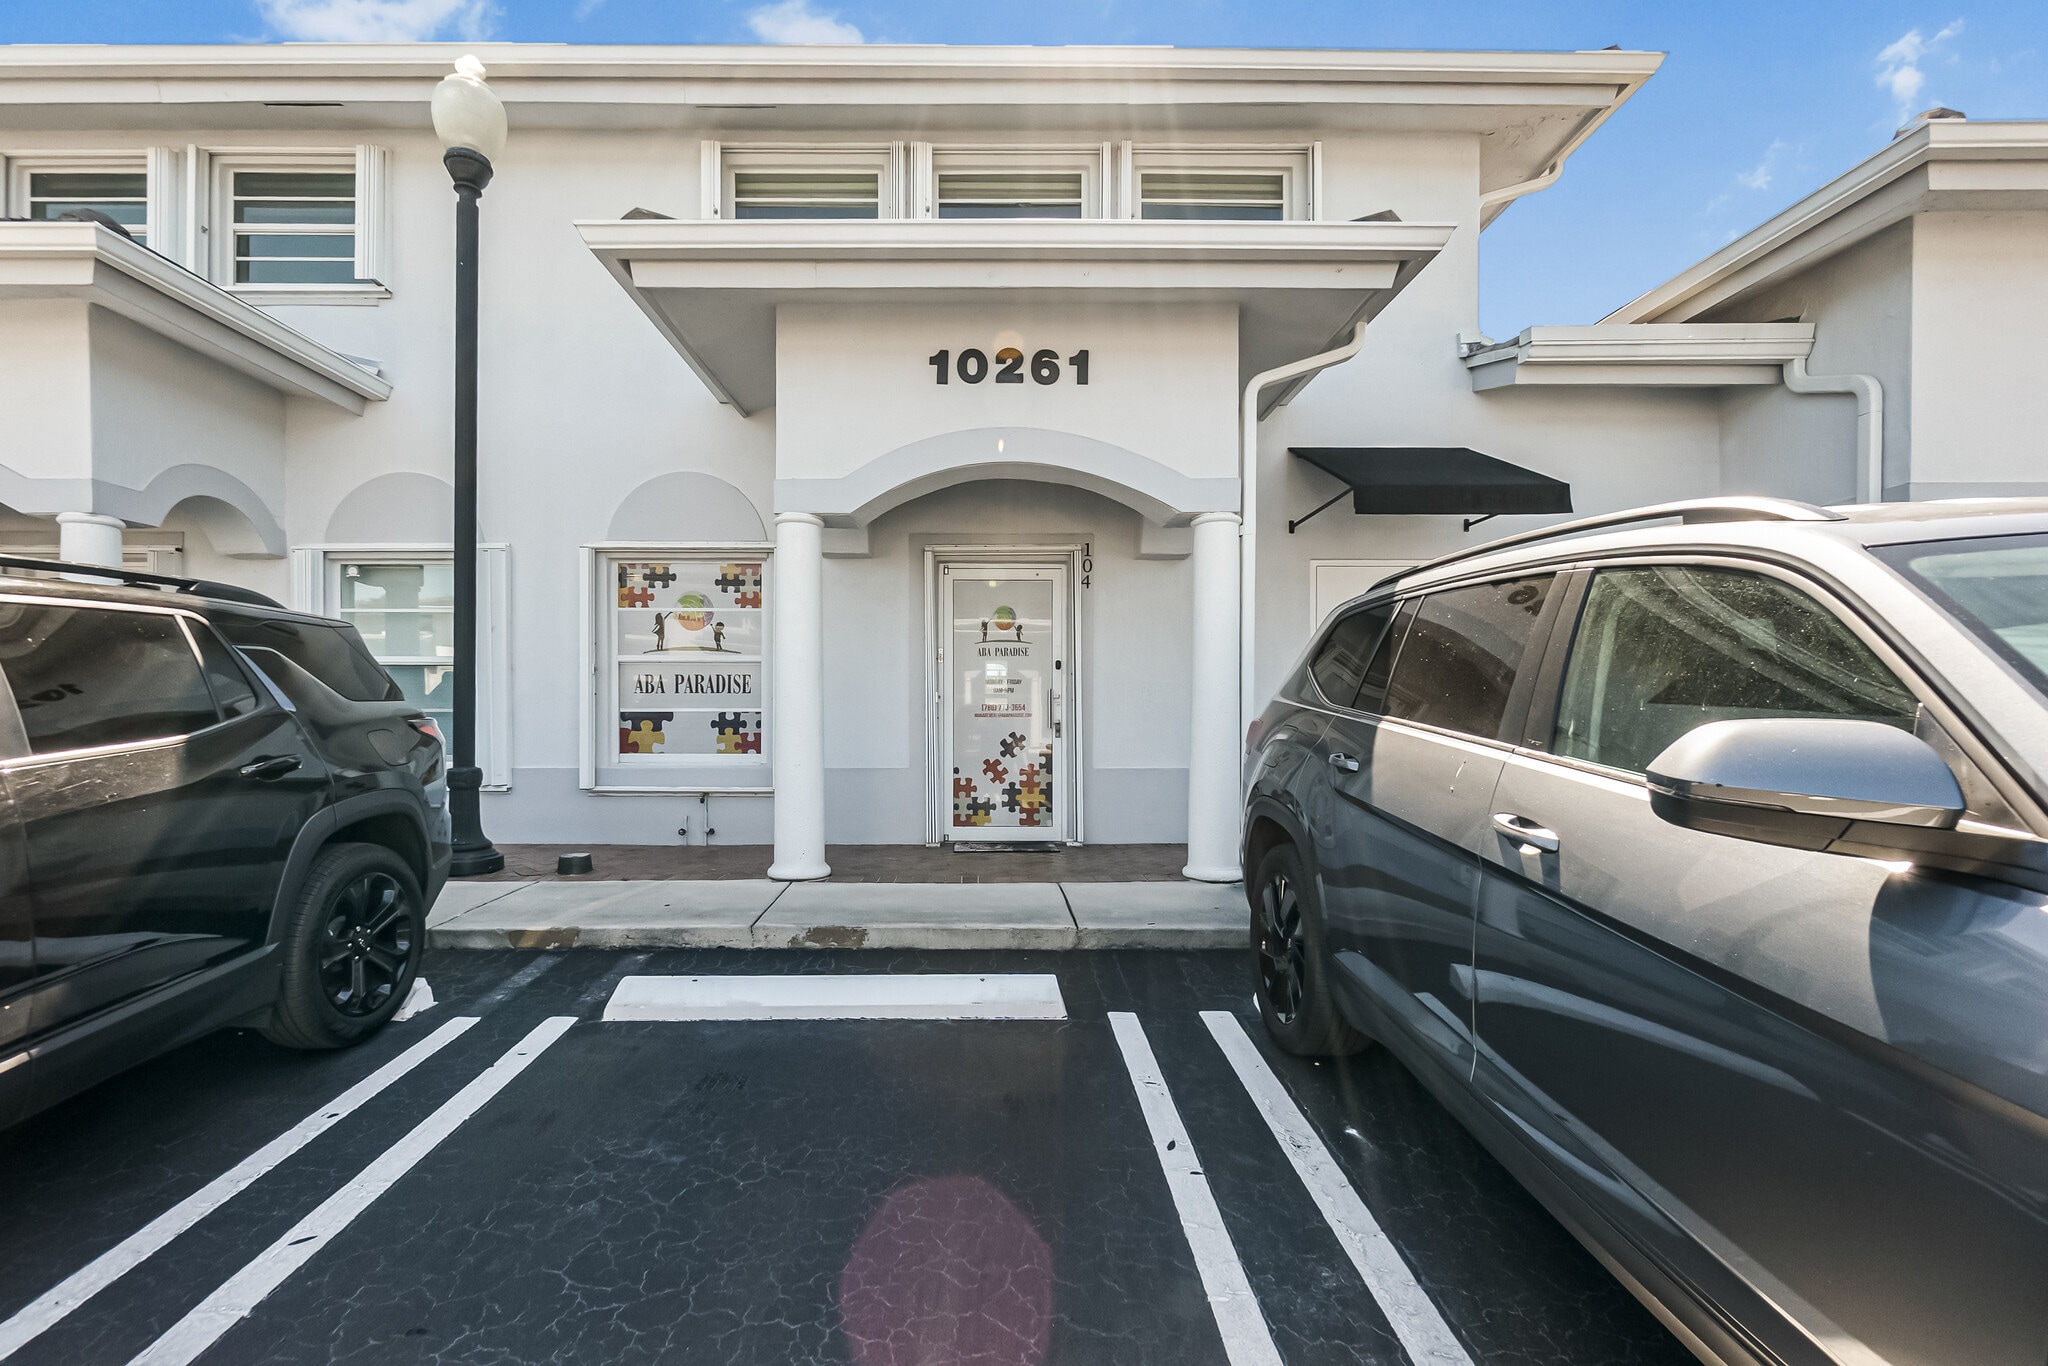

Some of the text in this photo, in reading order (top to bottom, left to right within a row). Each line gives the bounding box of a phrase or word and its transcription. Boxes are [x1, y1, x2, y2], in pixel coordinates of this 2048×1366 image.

[928, 347, 1089, 385] 10261
[1081, 543, 1093, 589] 104
[978, 648, 1030, 656] ABA PARADISE
[634, 673, 752, 694] ABA PARADISE
